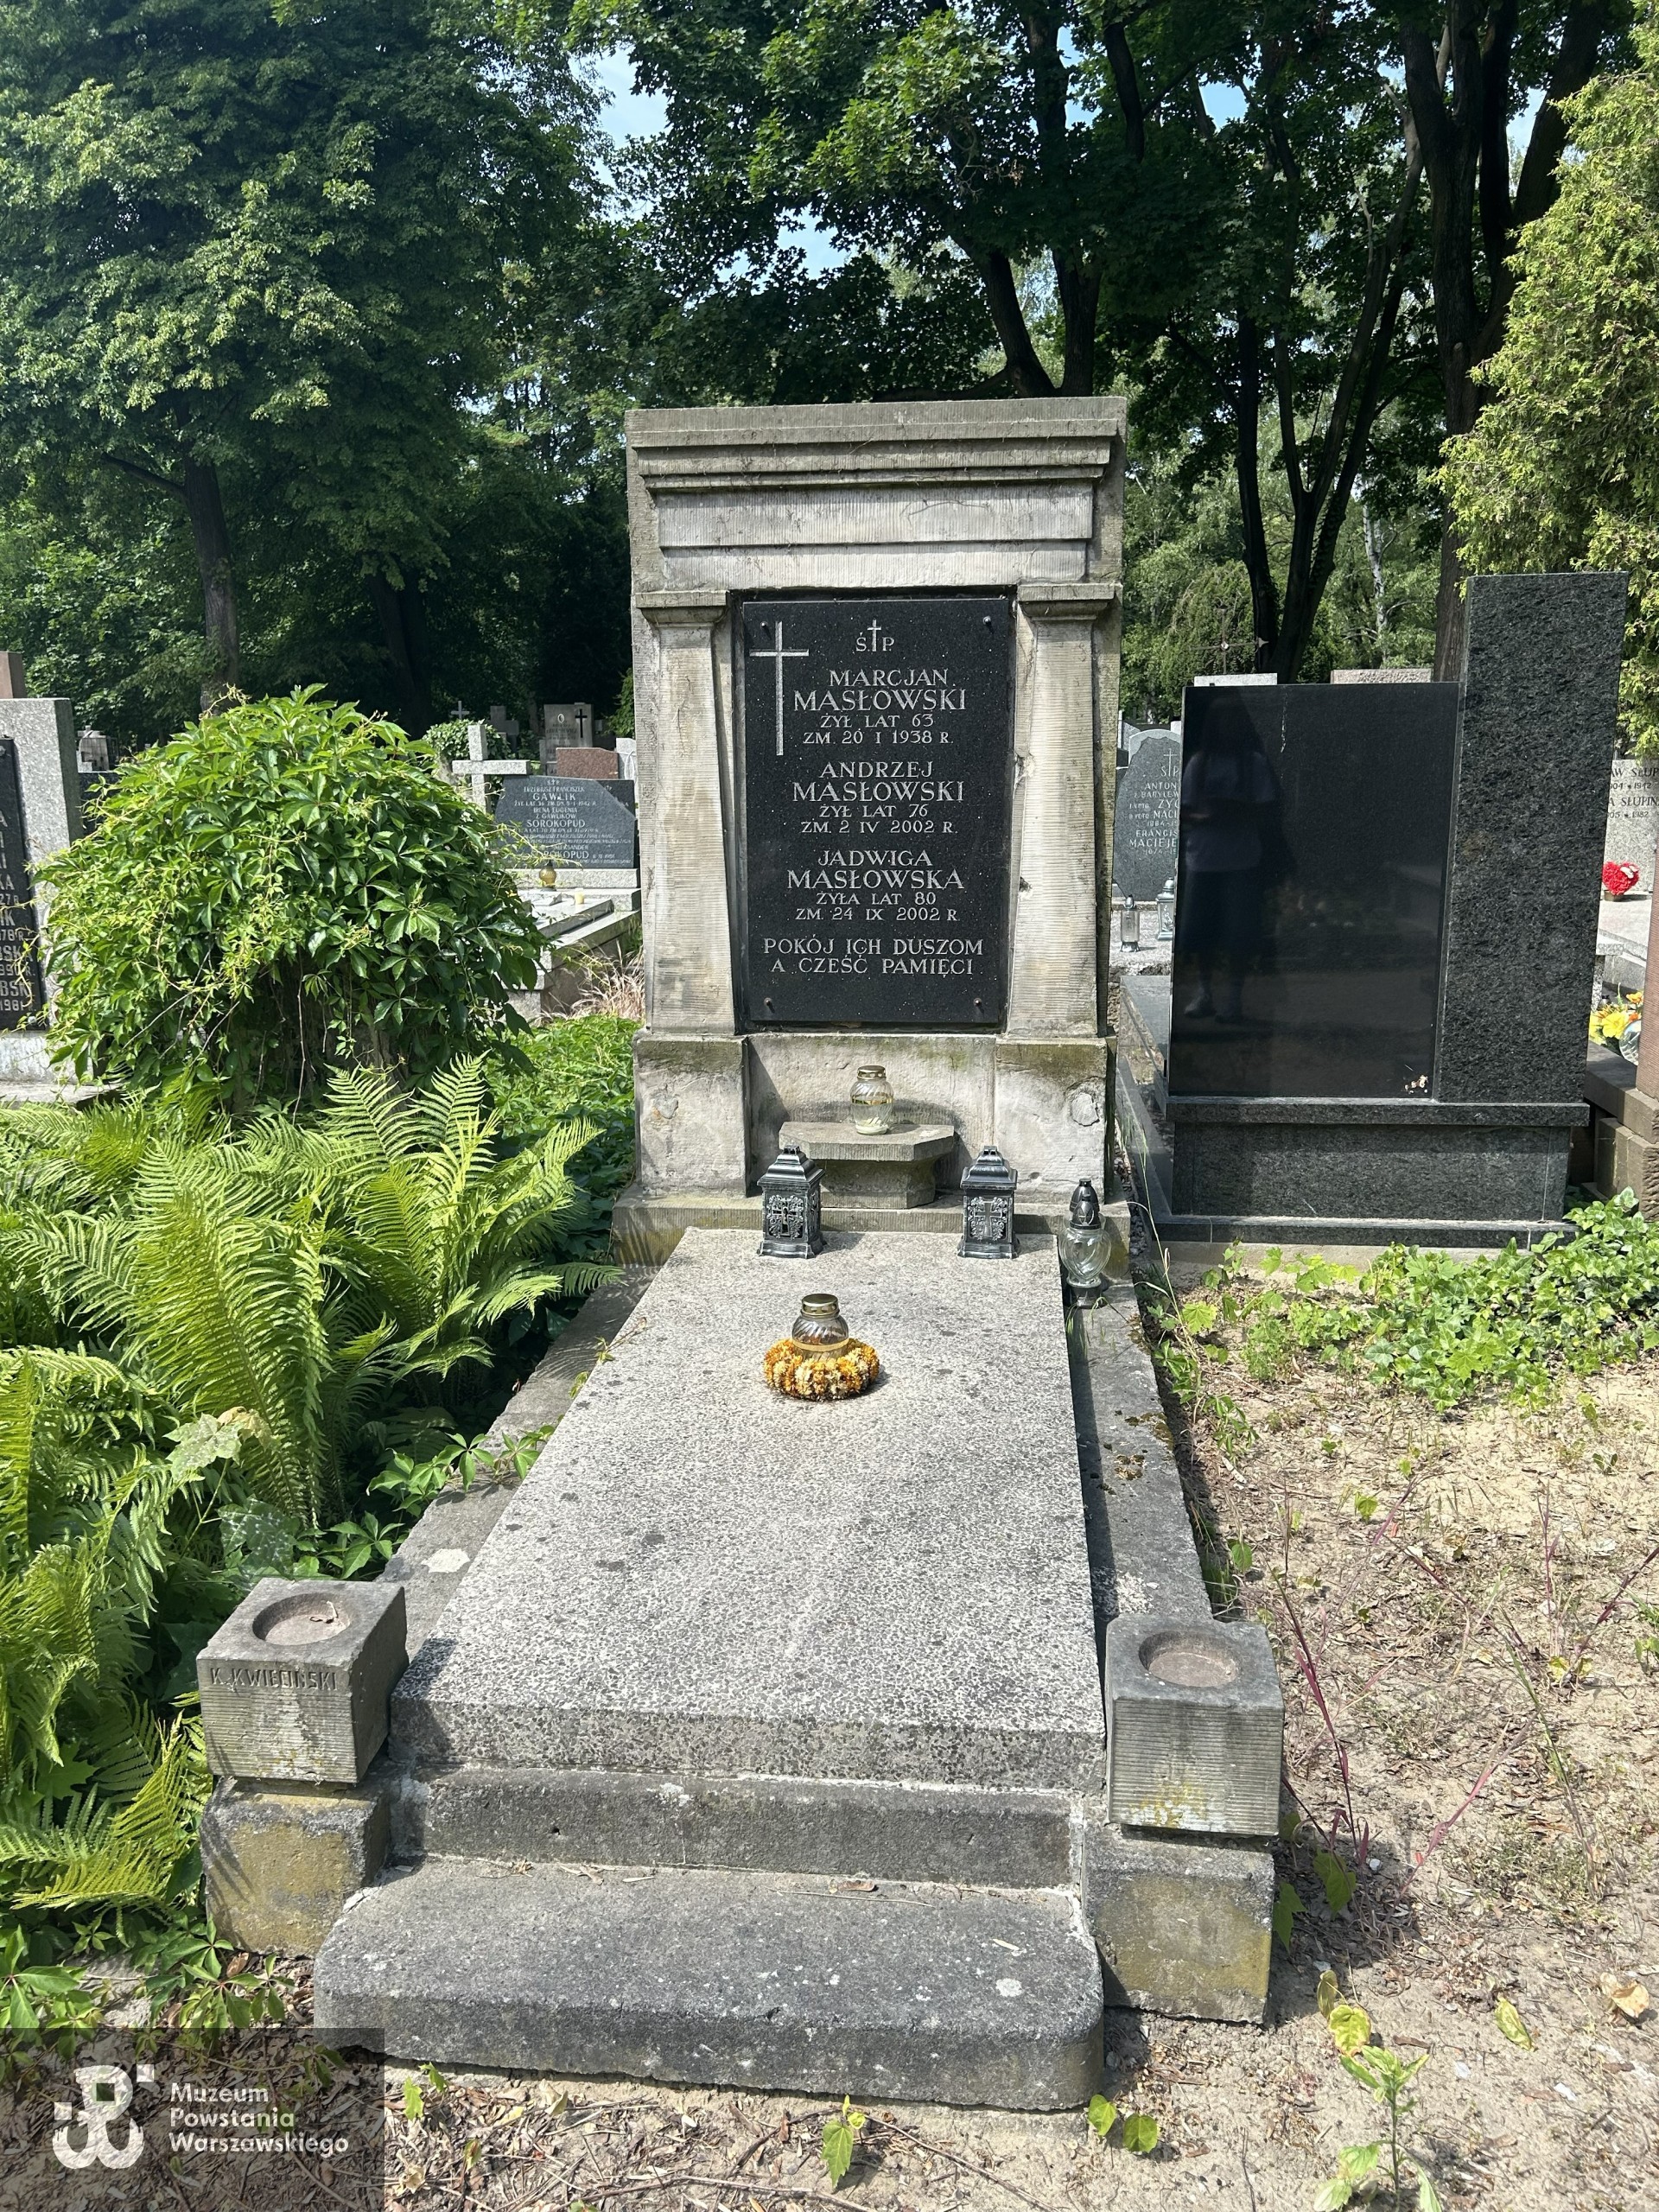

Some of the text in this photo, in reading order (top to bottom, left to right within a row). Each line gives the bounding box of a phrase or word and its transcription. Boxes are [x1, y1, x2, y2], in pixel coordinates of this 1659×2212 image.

[829, 668, 949, 687] MARCJAN
[793, 689, 967, 712] MASŁOWSKI
[820, 713, 934, 728] ŻYŁ LAT 63
[803, 730, 954, 745] ZM. 20 I 1938 R.
[819, 760, 934, 779] ANDRZEJ
[532, 792, 576, 801] GAWLIK
[792, 780, 965, 802] MASŁOWSKI
[819, 804, 930, 817] ŻYŁ LAT 76
[526, 819, 586, 828] SOROKOPUD
[800, 819, 958, 834] ZM. 2 IV 2002 R.
[817, 849, 933, 867] JADWIGA
[787, 868, 965, 889] MASŁOWSKA
[816, 890, 937, 906] ŻYŁA LAT 80
[795, 908, 824, 921] ZM.
[831, 907, 854, 921] 24
[865, 908, 885, 921] IX
[896, 907, 941, 921] 2002
[763, 934, 984, 956] POKÓJ ICH DUSZOM
[771, 954, 974, 978] A CZEŚĆ PAMIĘCI
